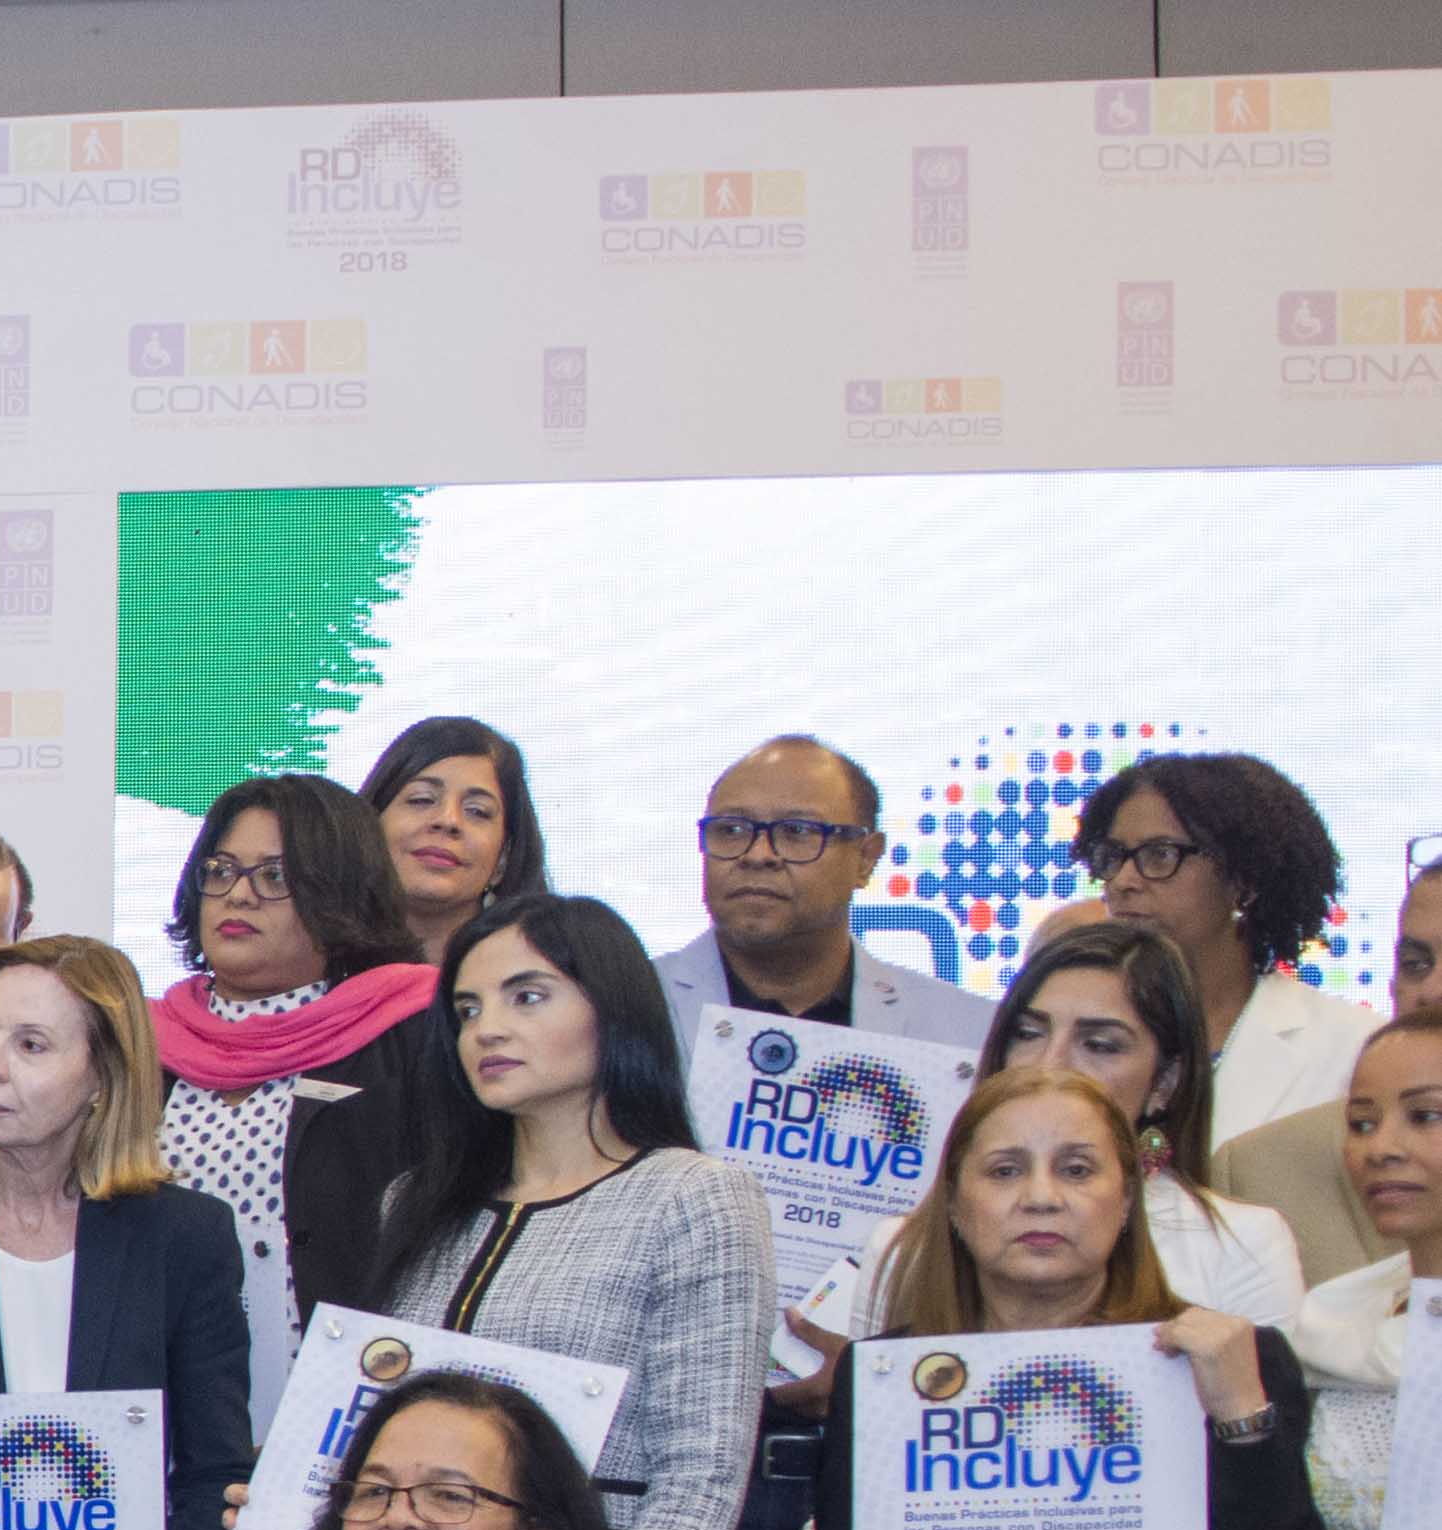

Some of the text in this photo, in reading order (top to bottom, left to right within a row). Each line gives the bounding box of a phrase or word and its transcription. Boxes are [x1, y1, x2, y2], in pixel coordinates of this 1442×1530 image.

[300, 148, 362, 182] RD
[1097, 138, 1333, 173] CONADIS
[287, 171, 463, 222] Incluye
[601, 223, 807, 253] CONADIS
[339, 251, 407, 273] 2018
[1281, 353, 1441, 383] CONA
[131, 380, 368, 414] CONADIS
[847, 417, 1004, 439] CONADIS
[745, 1078, 819, 1127] RD
[725, 1102, 924, 1187] Incluye
[783, 1205, 841, 1230] 2018
[921, 1406, 1004, 1452] RD
[905, 1437, 1142, 1503] Incluye
[904, 1512, 957, 1524] Buenas
[1033, 1507, 1104, 1519] Inclusivas
[1109, 1506, 1142, 1518] para
